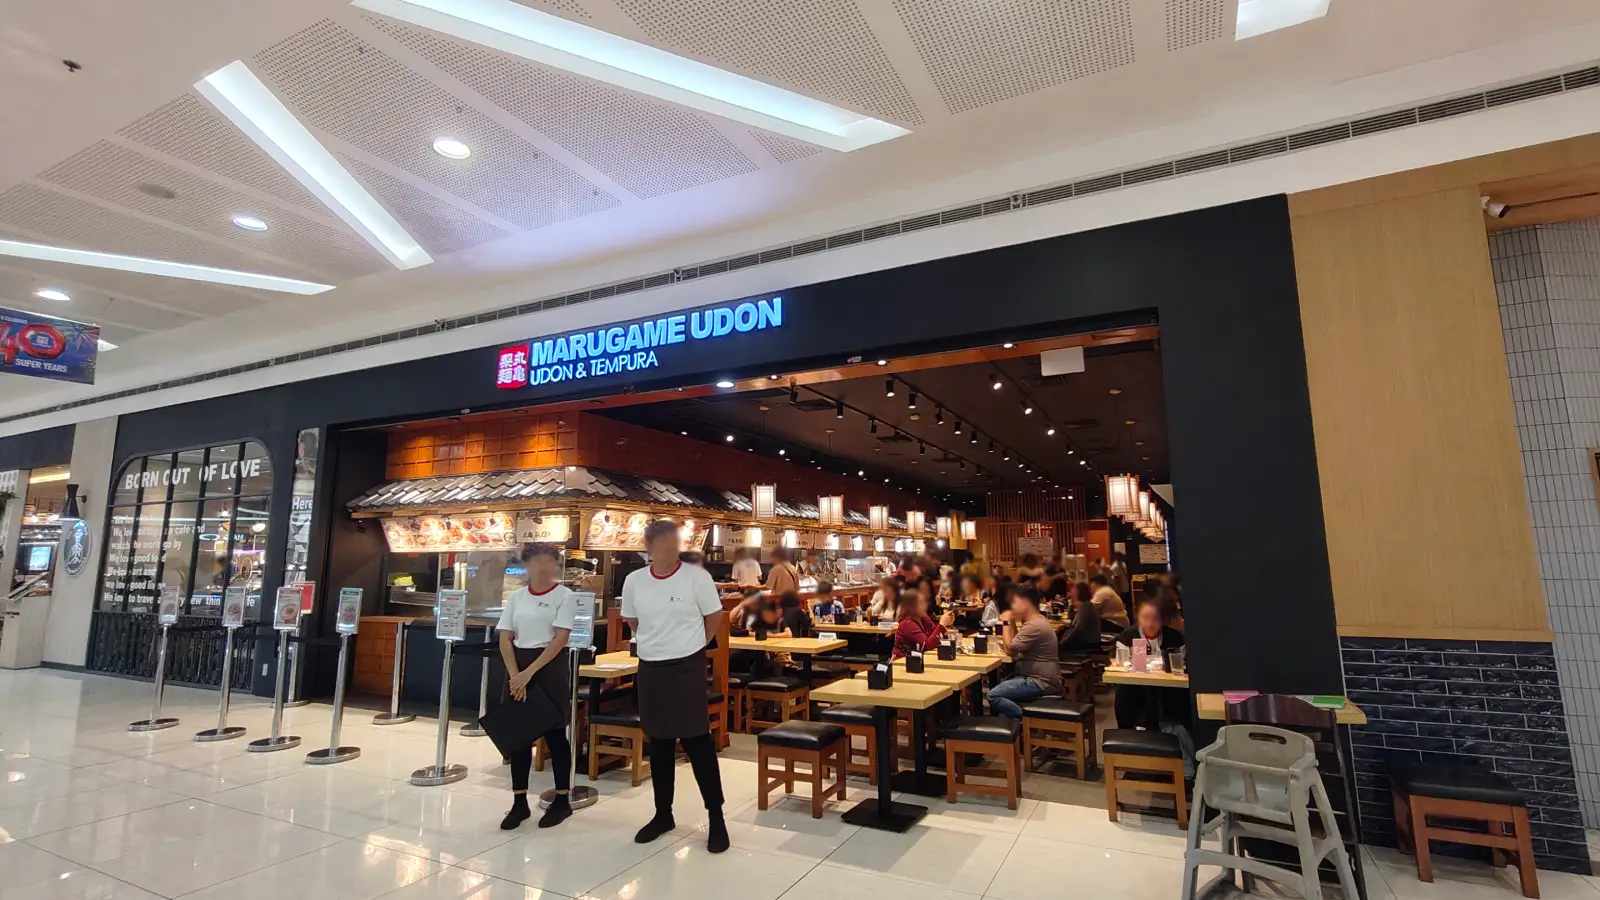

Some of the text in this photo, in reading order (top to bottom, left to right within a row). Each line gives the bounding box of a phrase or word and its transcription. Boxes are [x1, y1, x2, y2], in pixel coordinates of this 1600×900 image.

[531, 297, 783, 366] MARUGAME UDON
[15, 359, 68, 373] SUPER YEARS
[530, 350, 659, 386] UDON & TEMPURA
[221, 459, 261, 480] LOVE
[292, 499, 314, 511] Here
[163, 541, 172, 551] go
[173, 540, 182, 550] by
[134, 554, 150, 564] good
[151, 554, 166, 562] fod
[130, 580, 147, 591] good
[103, 592, 113, 601] We
[114, 592, 125, 602] lov
[128, 594, 136, 602] to
[137, 594, 154, 603] trave
